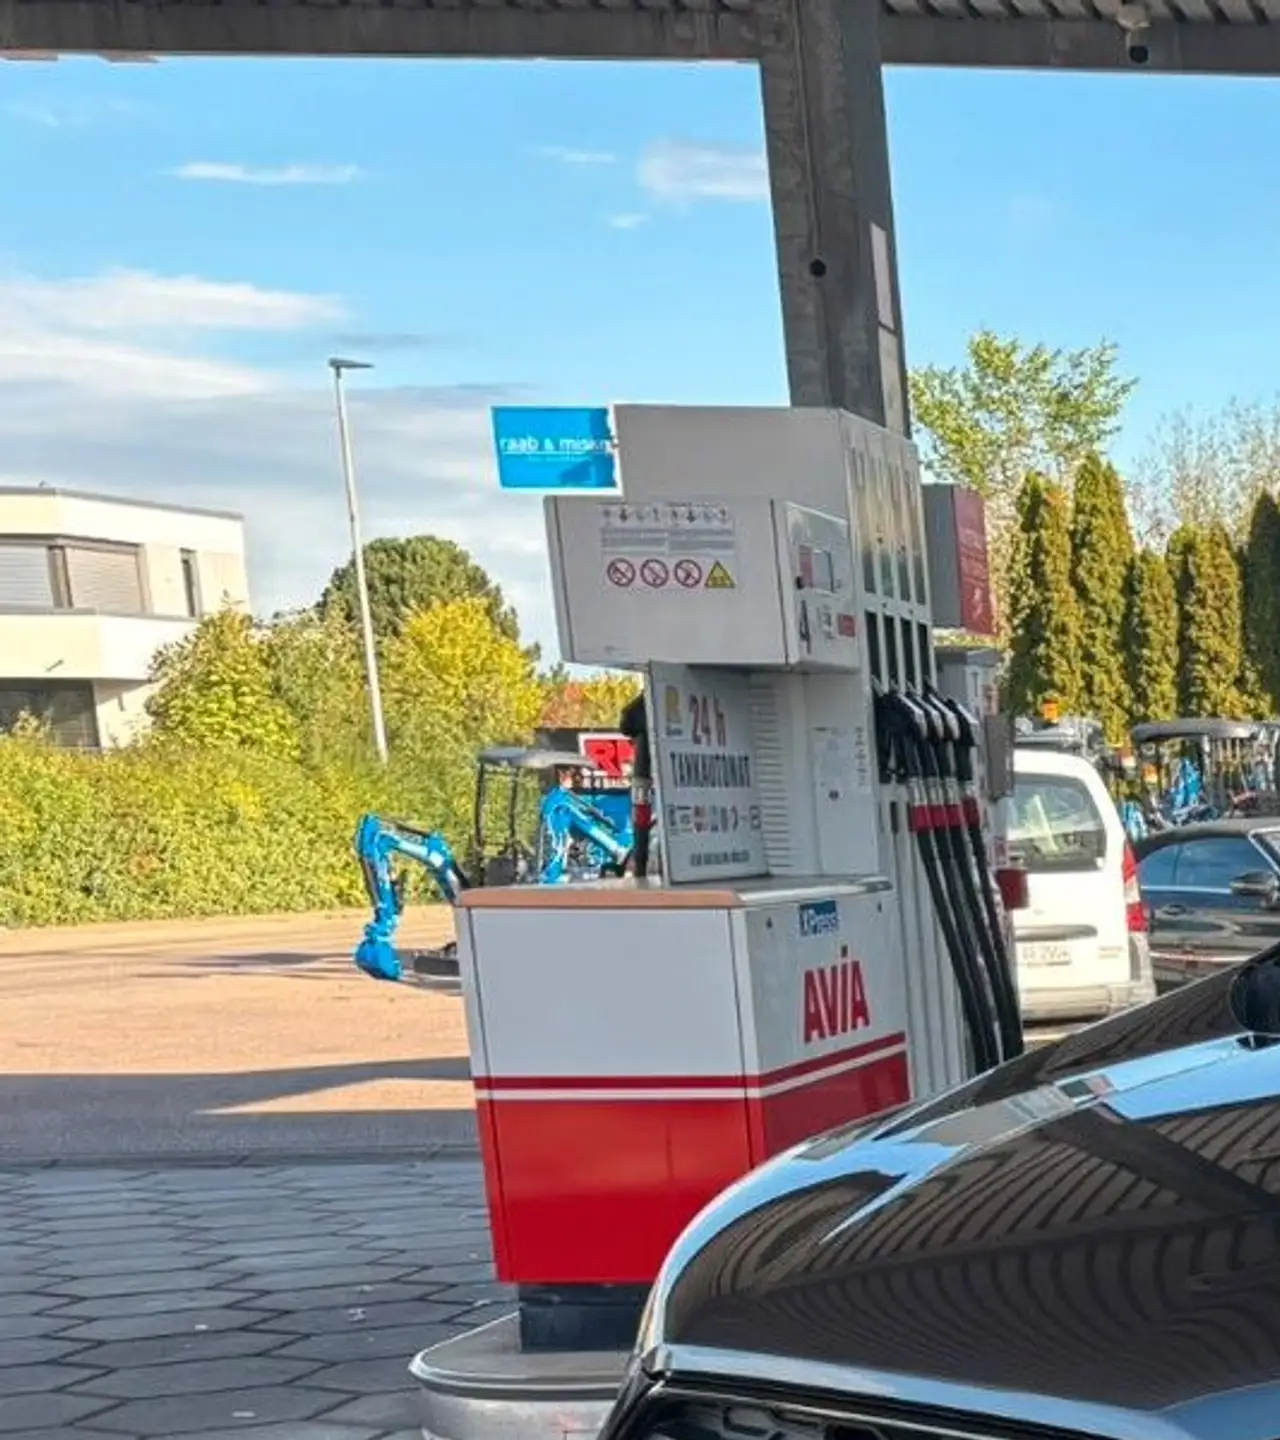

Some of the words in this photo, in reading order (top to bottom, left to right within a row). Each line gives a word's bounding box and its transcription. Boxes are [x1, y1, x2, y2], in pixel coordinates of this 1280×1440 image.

[499, 432, 538, 452] raab
[559, 435, 613, 454] miske
[689, 693, 712, 746] 24
[714, 691, 728, 746] h
[804, 959, 871, 1044] AVIA
